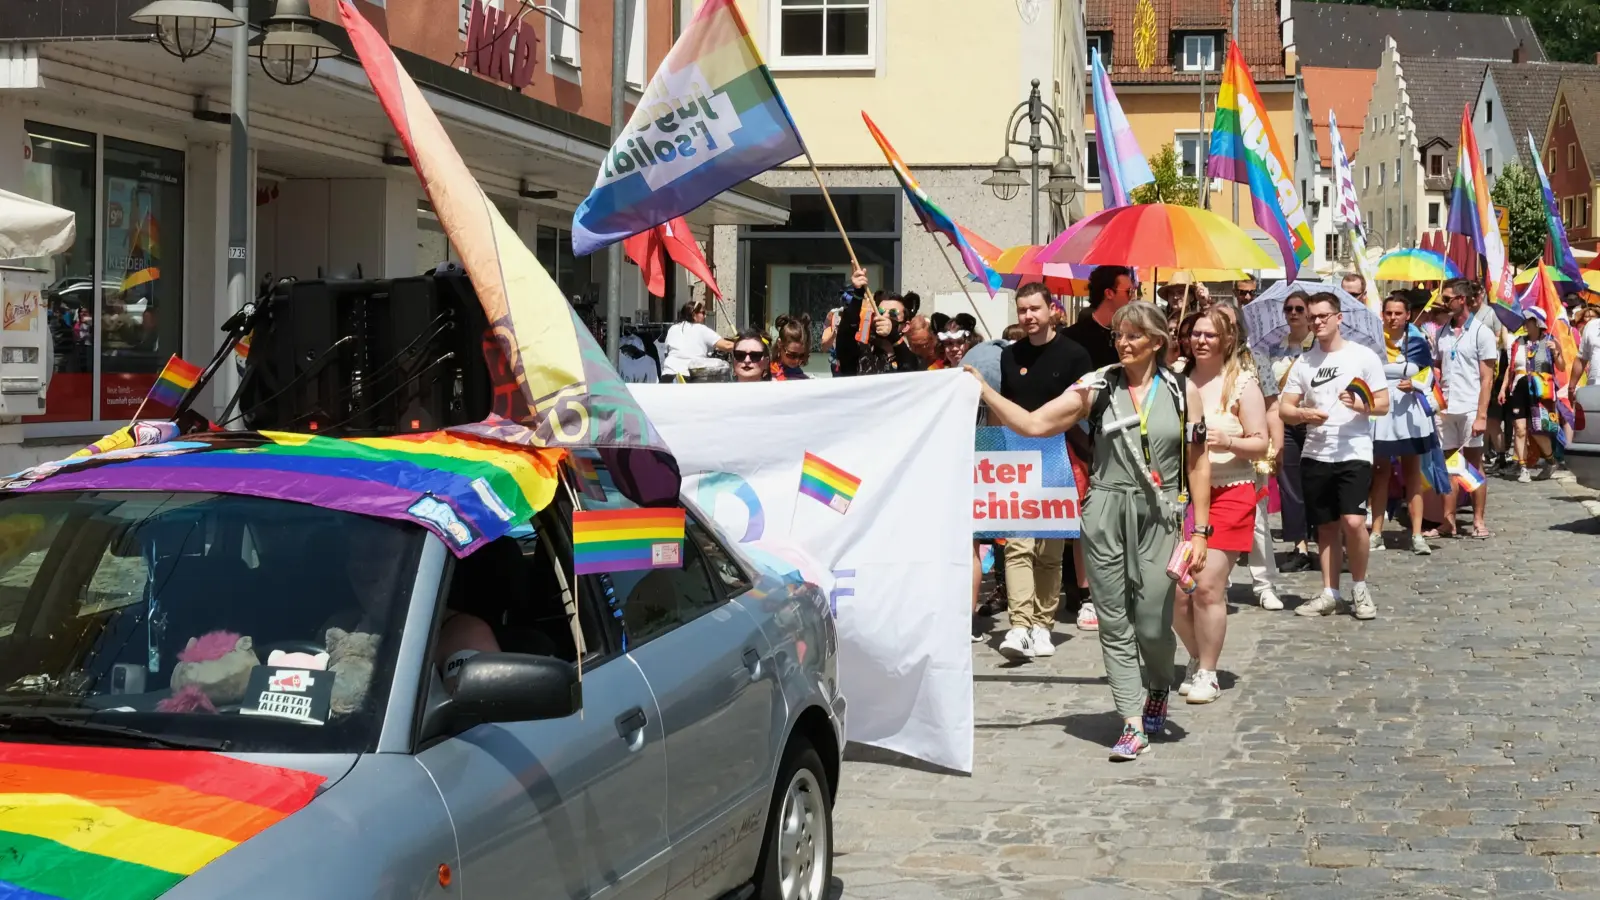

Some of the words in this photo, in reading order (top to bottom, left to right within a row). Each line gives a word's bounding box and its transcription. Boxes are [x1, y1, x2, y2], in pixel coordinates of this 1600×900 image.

[464, 0, 537, 89] NKD
[1316, 366, 1339, 379] NIKE
[262, 693, 309, 706] ALERTA!
[261, 702, 307, 716] ALERTA!
